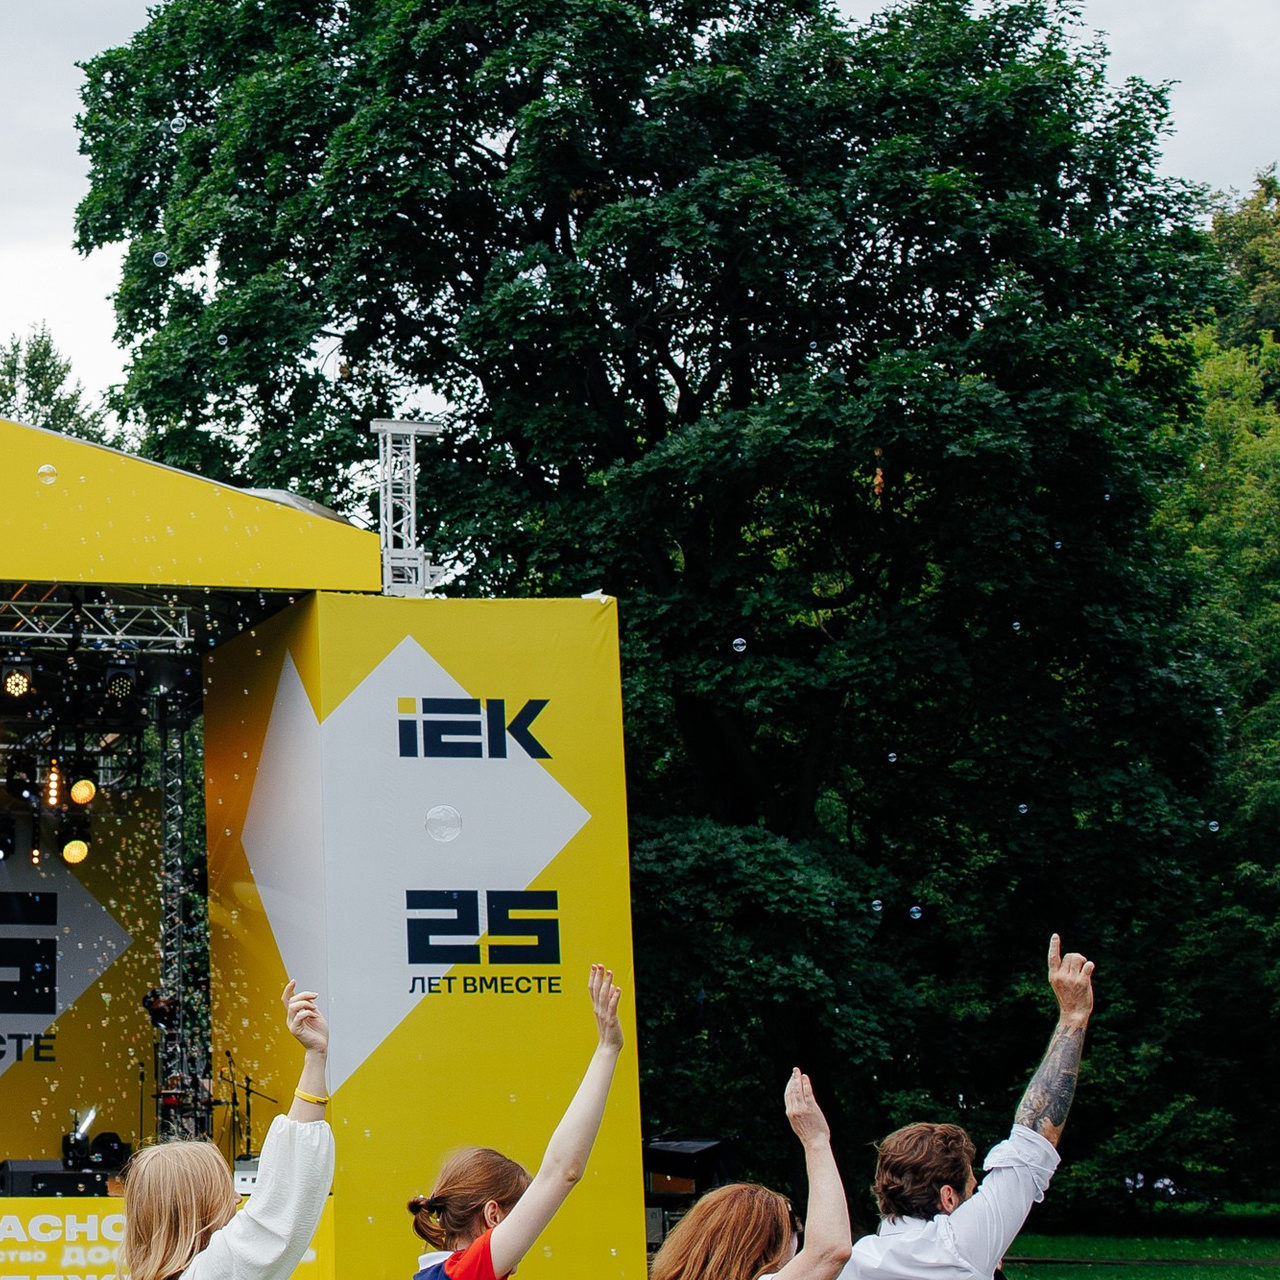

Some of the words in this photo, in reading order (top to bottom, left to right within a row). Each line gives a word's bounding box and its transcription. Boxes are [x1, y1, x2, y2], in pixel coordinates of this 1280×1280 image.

[405, 889, 561, 964] 25
[409, 976, 455, 994] ЛЕТ
[463, 976, 562, 994] ВМЕСТЕ
